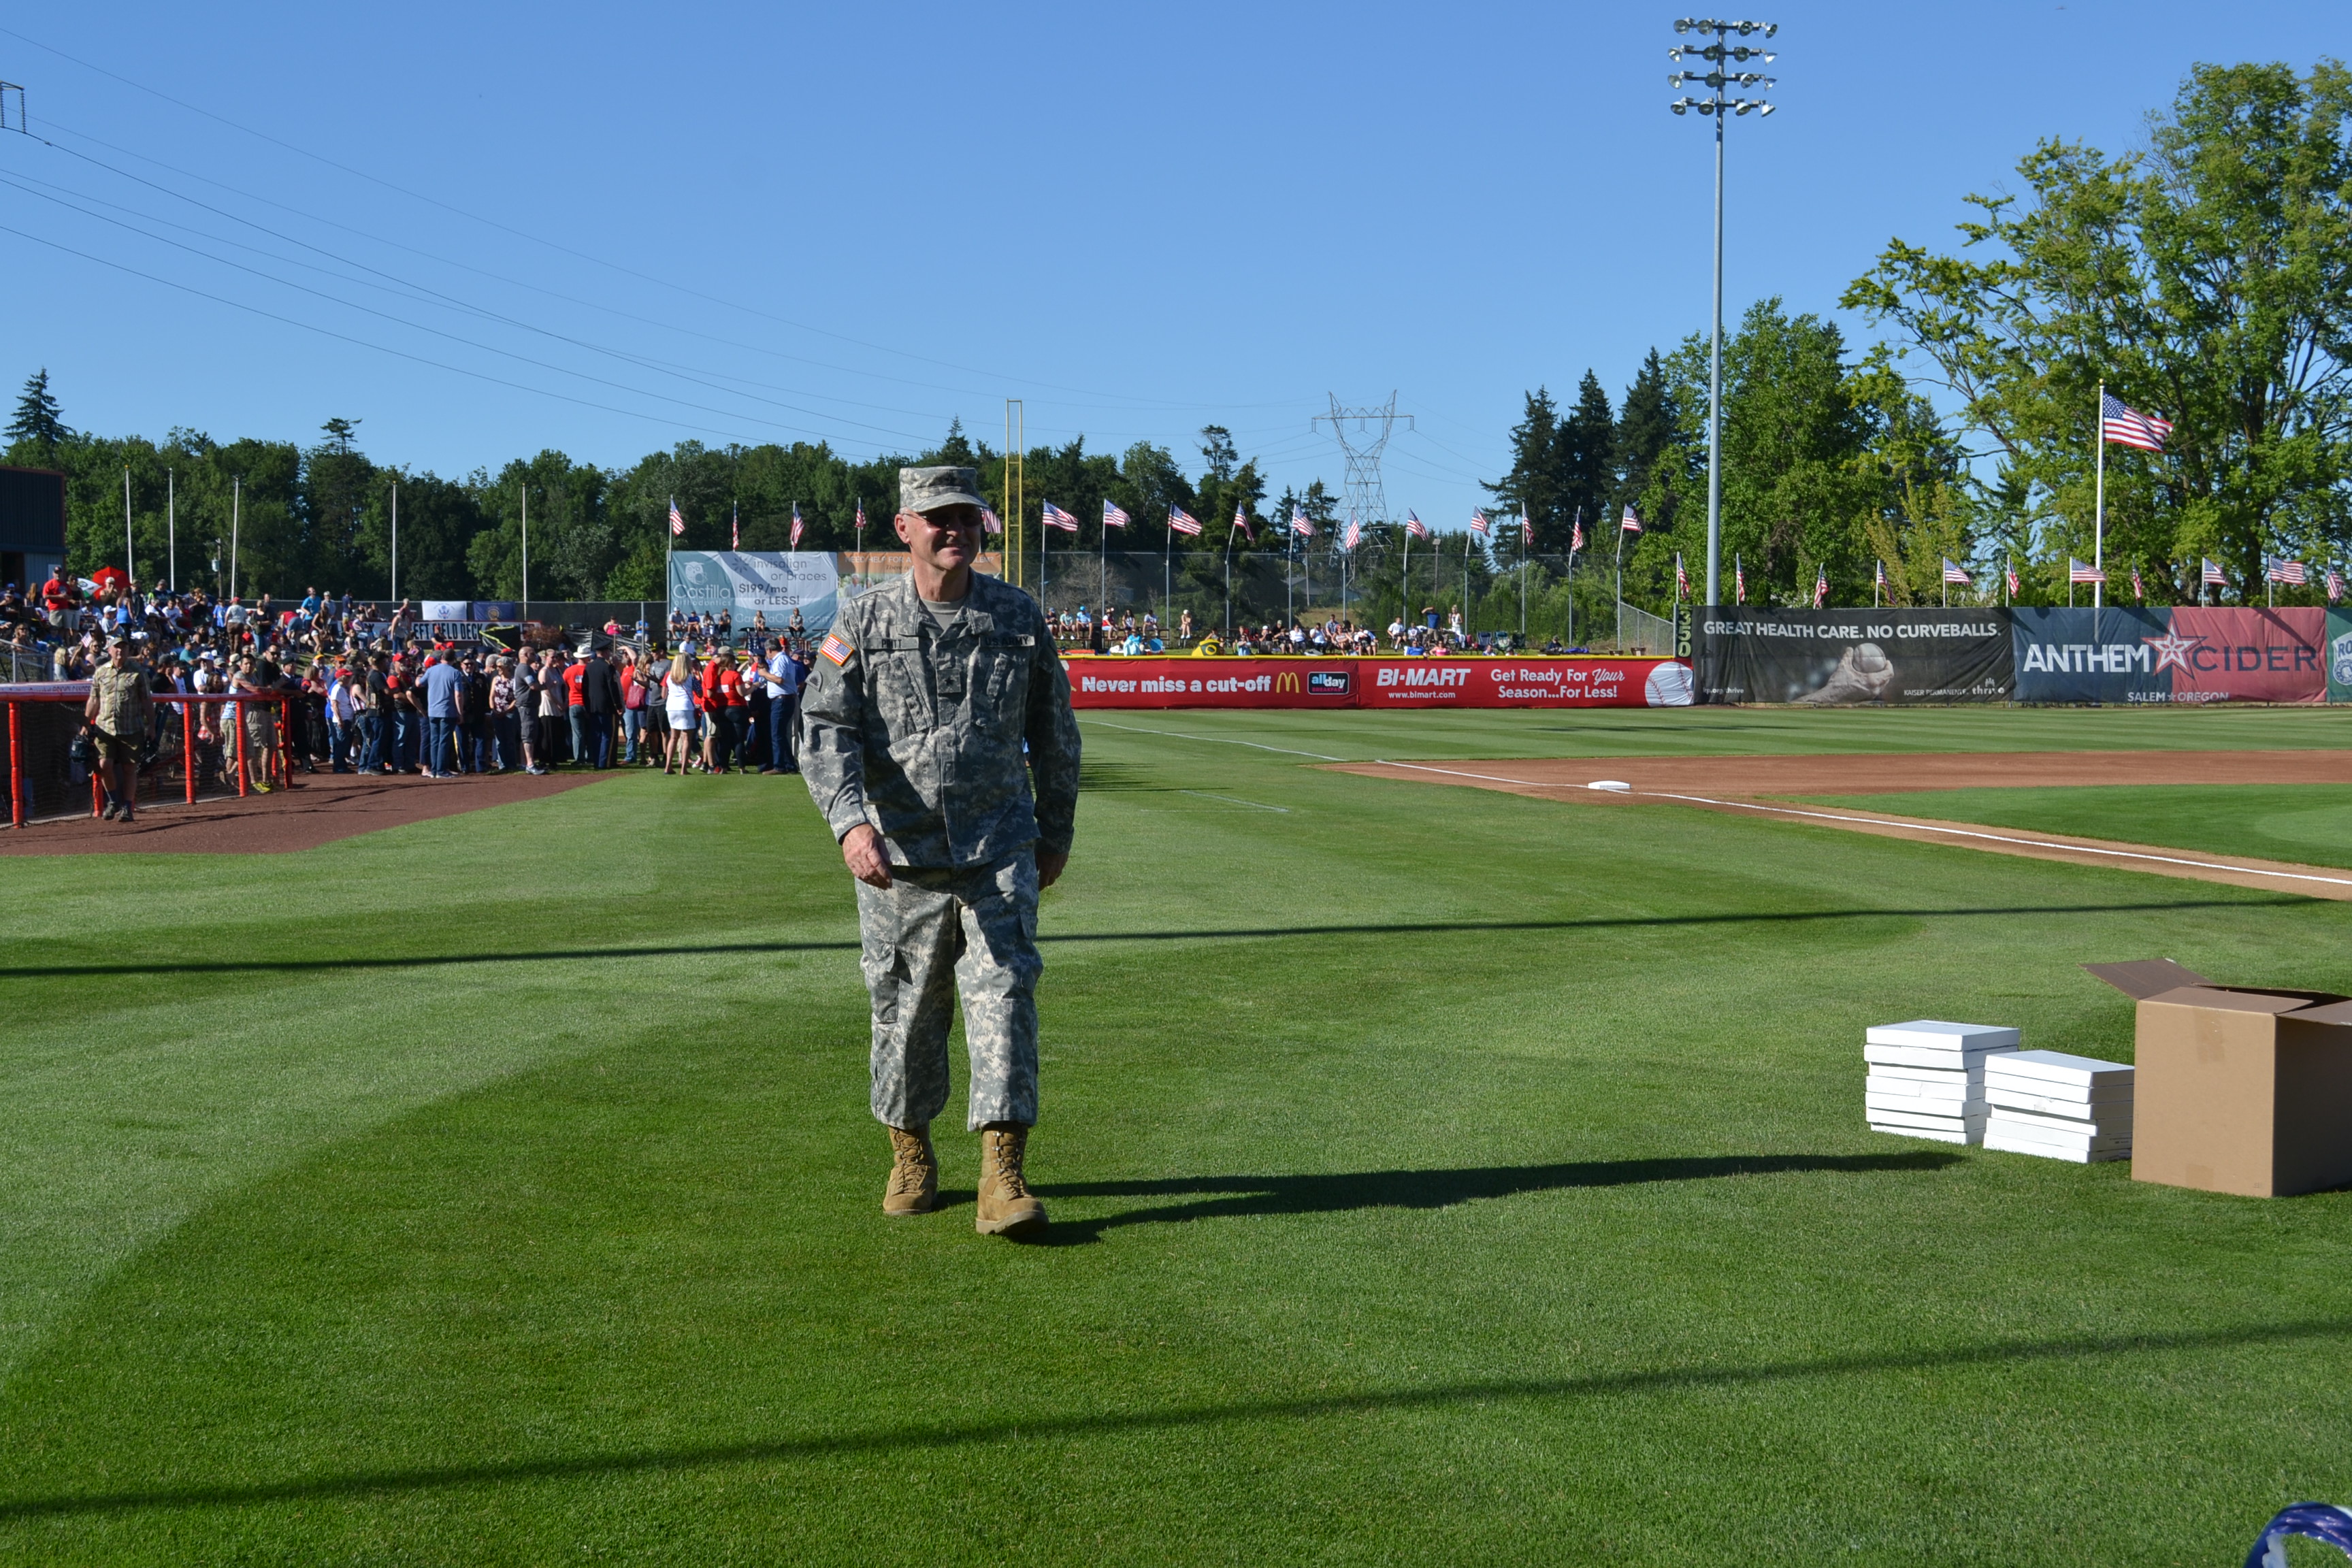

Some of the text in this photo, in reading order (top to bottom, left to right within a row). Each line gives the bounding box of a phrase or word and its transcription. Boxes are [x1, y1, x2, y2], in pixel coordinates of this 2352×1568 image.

[753, 558, 806, 571] invisalign
[787, 571, 827, 581] Braces
[673, 584, 731, 599] Castilla
[739, 583, 788, 594] $199/mo
[769, 595, 800, 605] LESS!
[413, 623, 429, 640] EFT
[1678, 610, 1692, 657] 350
[1703, 621, 2002, 639] GREAT HEALTH CARE. NO CURVEBALLS.
[1001, 636, 1028, 646] ARMY
[2023, 643, 2150, 672] ANTHEM
[2191, 645, 2318, 672] CIDER
[1490, 668, 1625, 685] Get Ready For Your
[1081, 675, 1271, 693] Never miss a cut-off
[1388, 690, 1456, 699] www.bimart.com
[1584, 685, 1618, 698] Less!
[2127, 691, 2229, 702] SALEM OREGON
